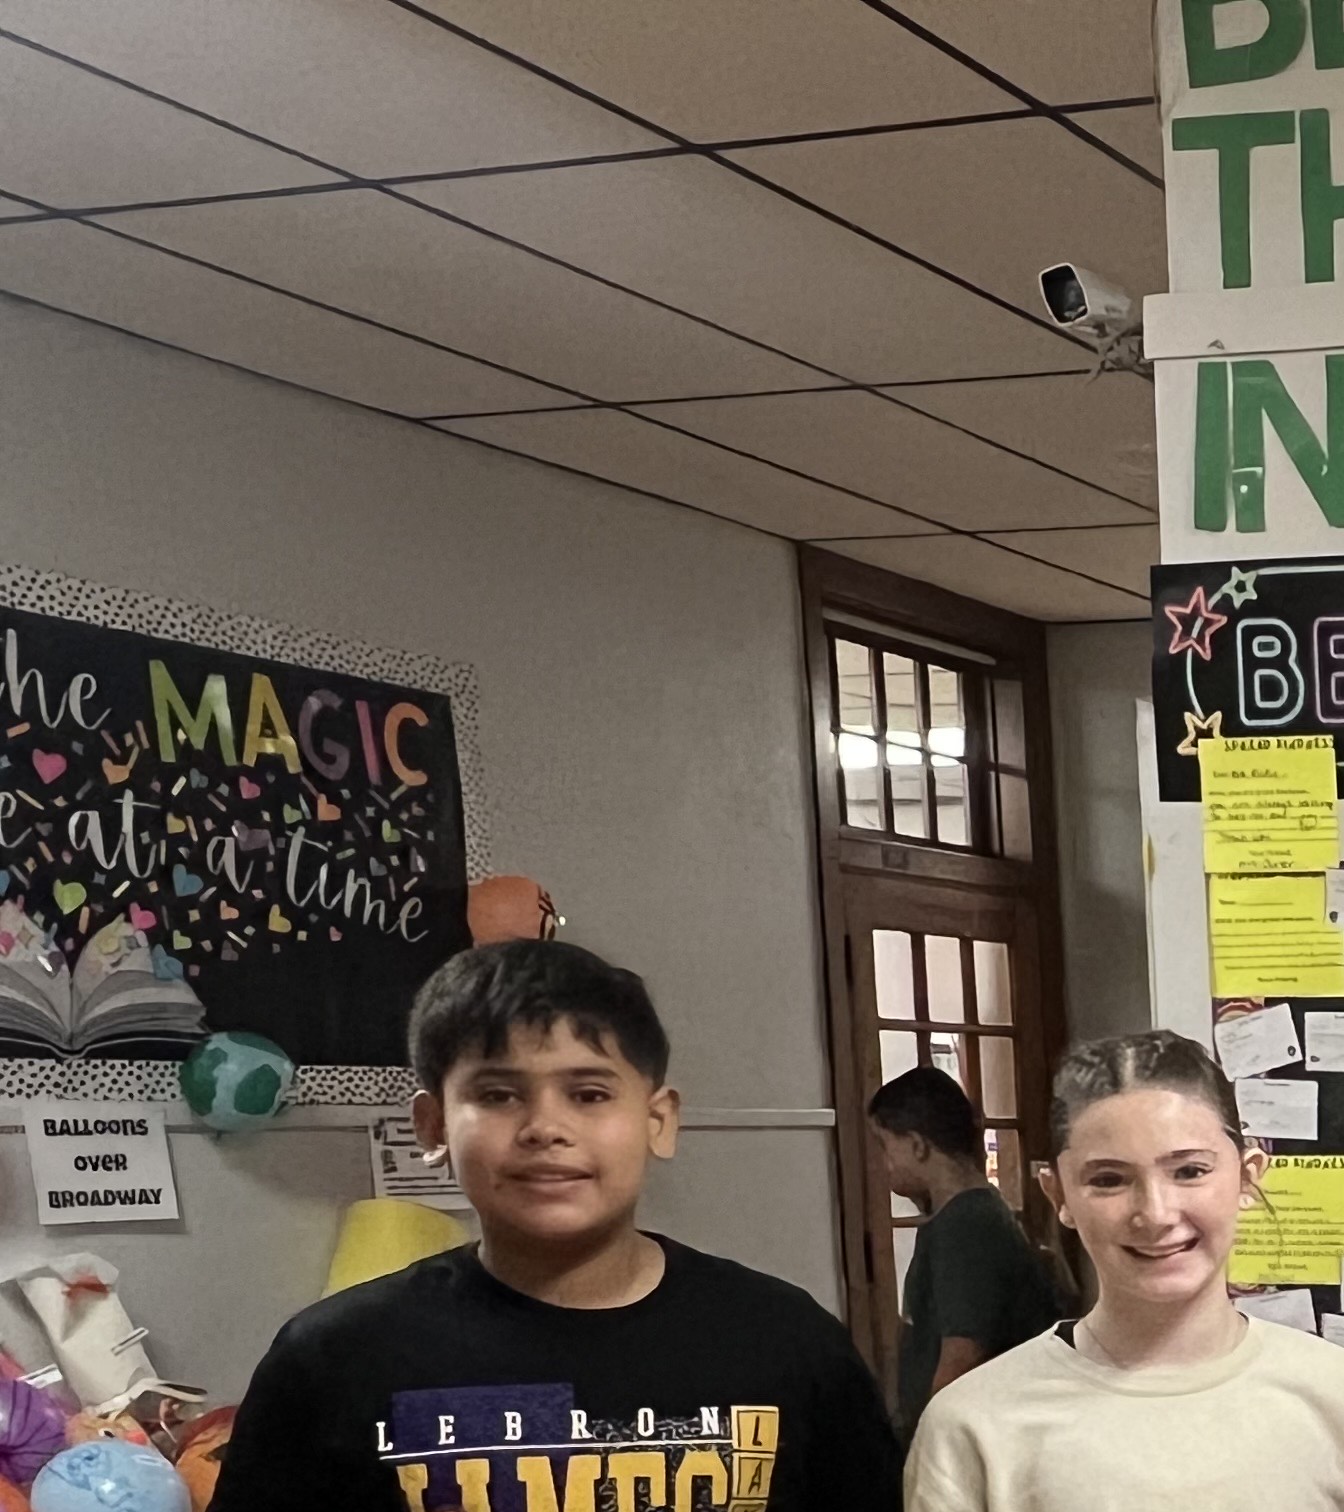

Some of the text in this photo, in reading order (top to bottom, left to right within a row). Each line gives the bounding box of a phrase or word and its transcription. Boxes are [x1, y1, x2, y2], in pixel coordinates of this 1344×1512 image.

[0, 628, 430, 787] he MAGIC
[68, 788, 161, 879] at
[206, 834, 254, 893] a
[284, 824, 429, 942] time
[48, 1188, 163, 1208] BROADWAY
[376, 1406, 720, 1452] LEBRON
